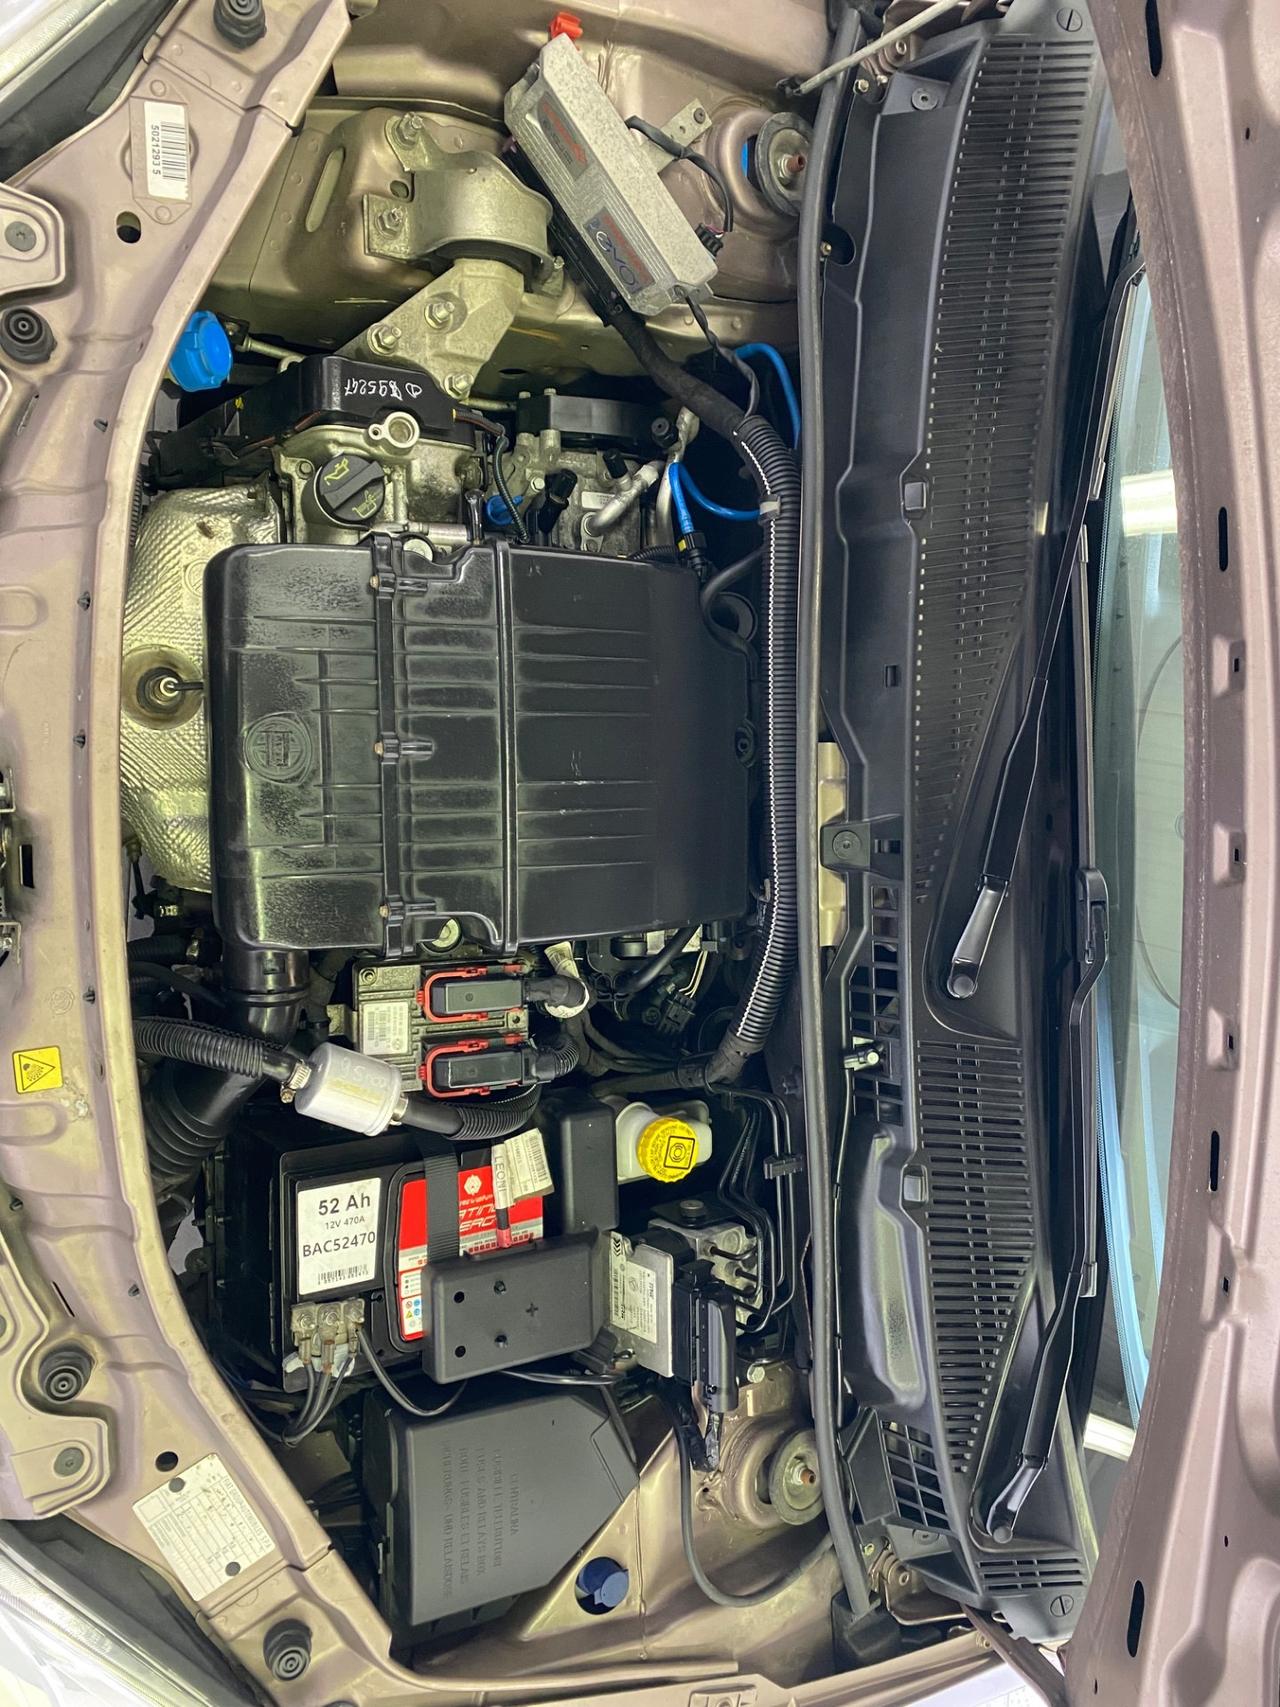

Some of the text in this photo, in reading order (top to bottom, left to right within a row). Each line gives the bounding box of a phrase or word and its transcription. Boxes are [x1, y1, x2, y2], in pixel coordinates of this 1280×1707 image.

[150, 124, 161, 166] 5021293
[495, 1156, 507, 1192] LEONI
[318, 1193, 371, 1216] 52 Ah
[325, 1216, 366, 1230] 12V 470A
[303, 1231, 376, 1257] BAC52470
